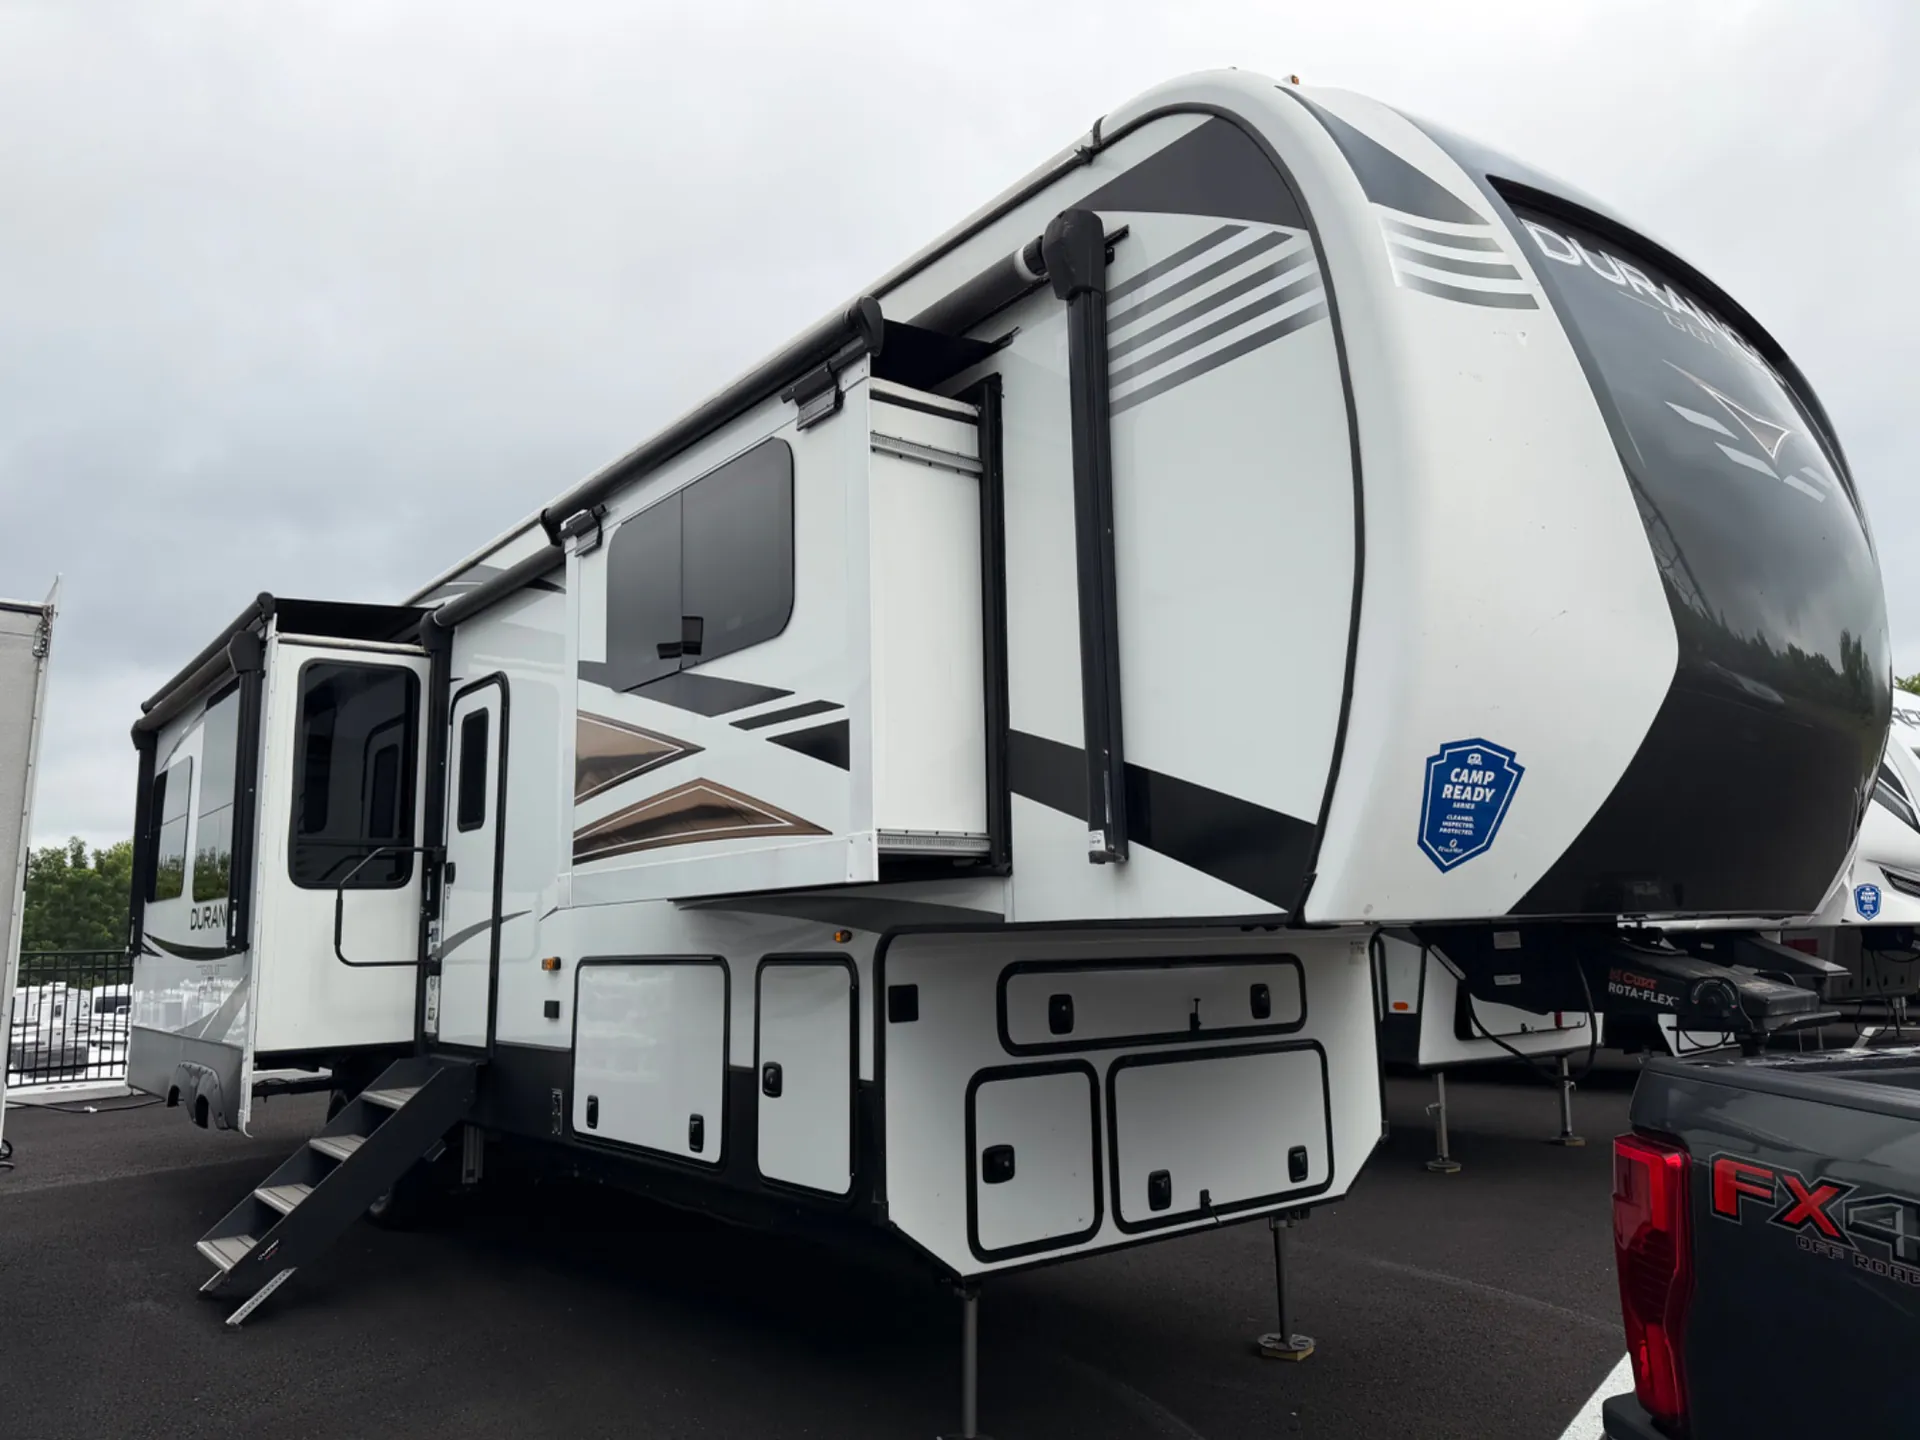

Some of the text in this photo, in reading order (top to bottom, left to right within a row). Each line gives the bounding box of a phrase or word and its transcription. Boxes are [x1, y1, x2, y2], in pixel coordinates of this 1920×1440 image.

[1450, 767, 1495, 785] CAMP
[1441, 784, 1496, 803] READY
[190, 904, 227, 930] DURAN
[1607, 981, 1674, 1007] ROTA-FLEX
[1709, 1151, 1920, 1270] FX4
[1796, 1235, 1844, 1259] OFF
